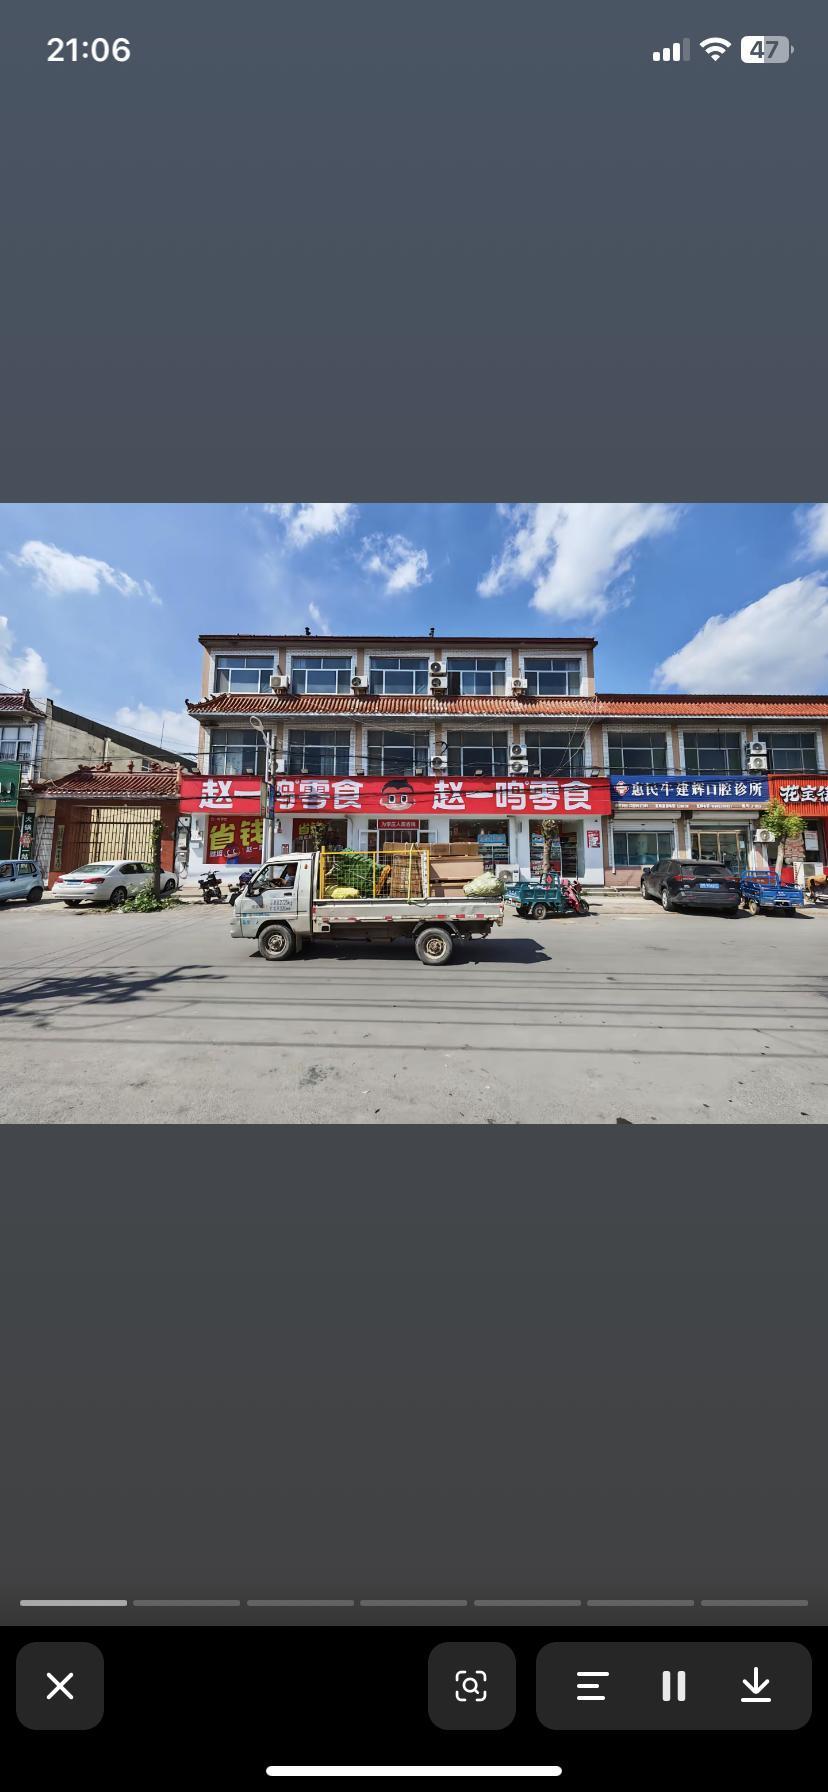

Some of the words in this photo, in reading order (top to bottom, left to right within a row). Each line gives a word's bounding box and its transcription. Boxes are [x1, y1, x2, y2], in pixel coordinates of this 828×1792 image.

[432, 779, 592, 811] 赵一鸣零食
[631, 781, 763, 797] 惠民牛建辉口腔诊所
